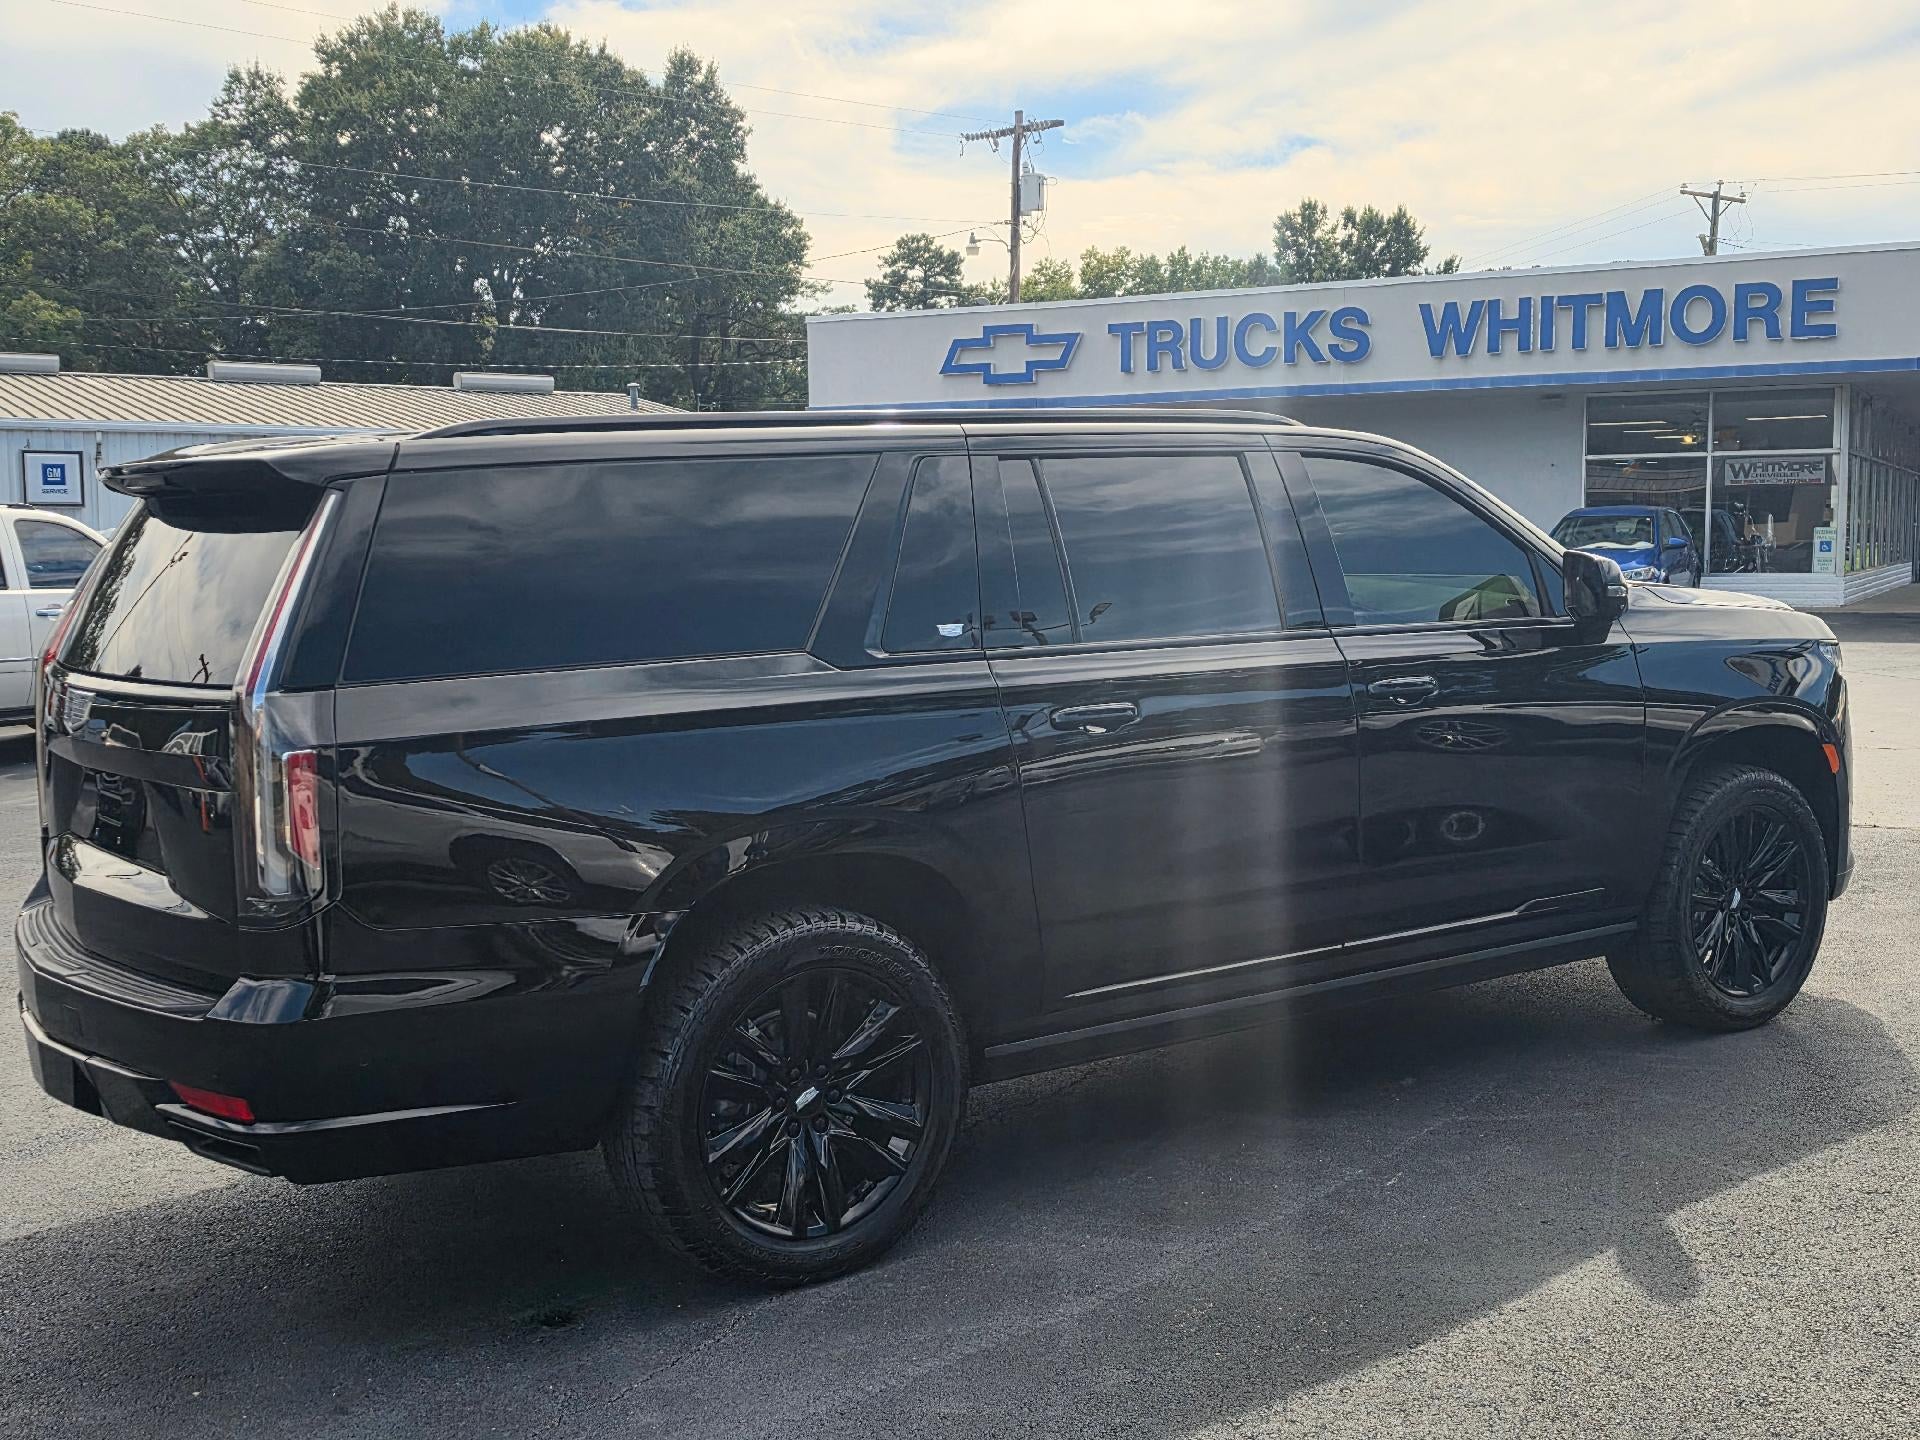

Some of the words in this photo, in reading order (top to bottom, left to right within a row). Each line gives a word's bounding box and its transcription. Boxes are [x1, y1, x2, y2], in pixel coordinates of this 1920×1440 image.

[1107, 306, 1372, 373] TRUCKS
[1418, 277, 1839, 358] WHITMORE
[46, 467, 61, 477] GM
[1728, 461, 1823, 479] WHITMORE
